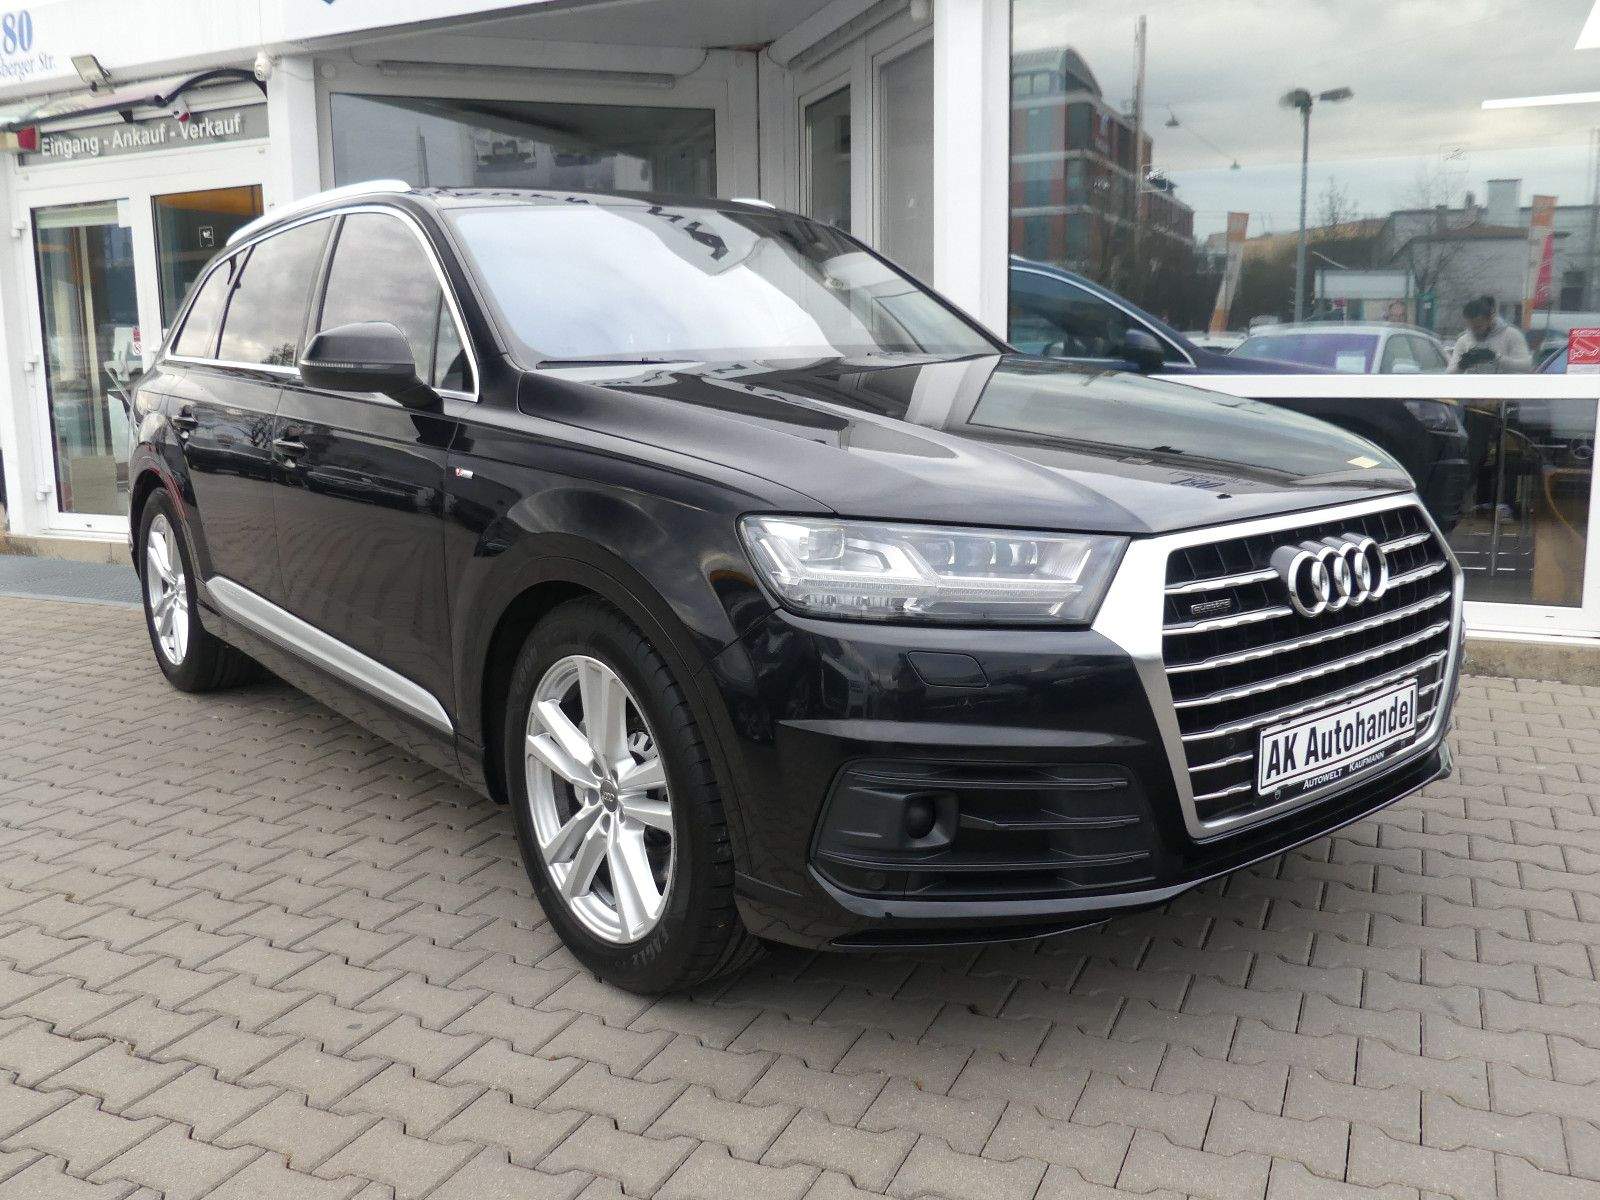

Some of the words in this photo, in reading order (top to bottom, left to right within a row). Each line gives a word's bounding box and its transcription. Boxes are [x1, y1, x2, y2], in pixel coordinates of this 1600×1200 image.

[2, 9, 33, 55] 80
[41, 135, 99, 159] Eingang
[112, 122, 166, 149] Ankauf
[179, 112, 241, 140] Verkauf
[1266, 731, 1299, 780] AK
[1304, 690, 1414, 766] Autohandel
[1302, 768, 1342, 790] AUTOWELT
[1349, 751, 1385, 772] KAUFMANN
